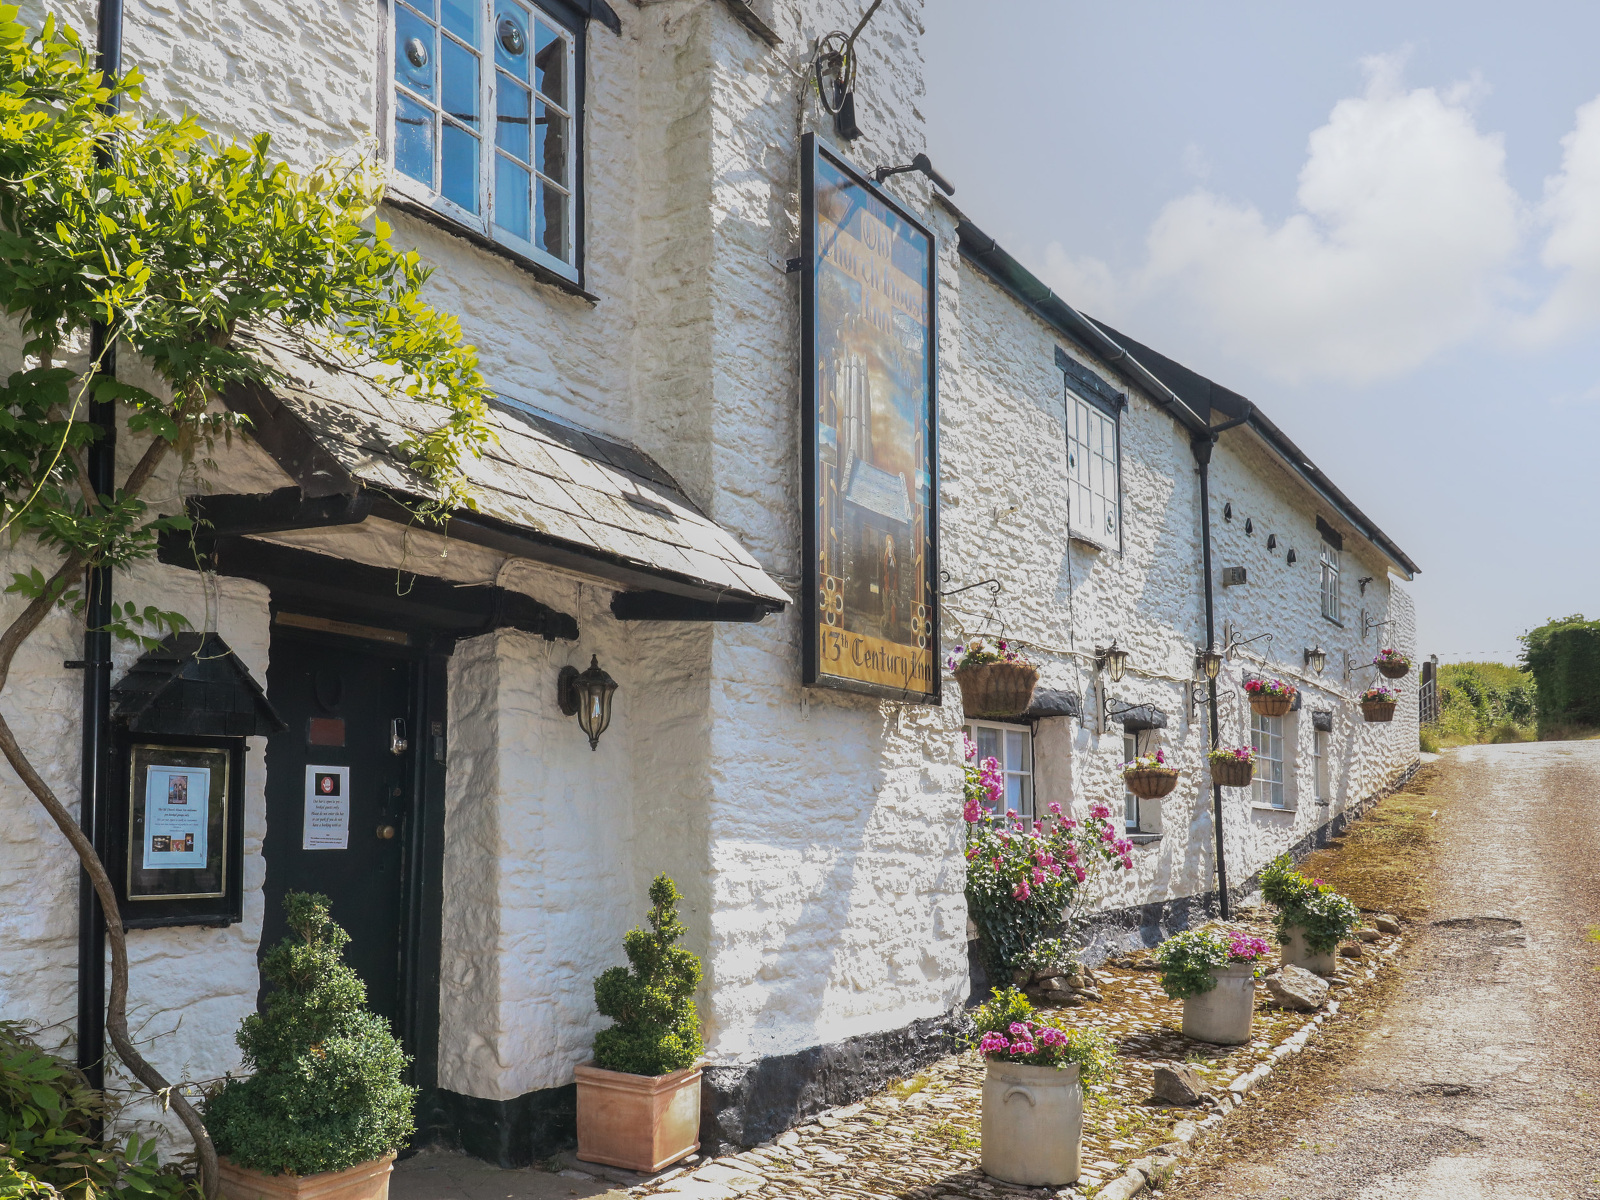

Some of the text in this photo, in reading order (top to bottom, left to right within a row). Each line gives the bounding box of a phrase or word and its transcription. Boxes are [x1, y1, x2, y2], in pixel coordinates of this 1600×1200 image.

[818, 221, 879, 292] Church
[863, 215, 890, 260] Old
[865, 289, 891, 335] Inn
[821, 630, 931, 683] 13th Century Inn
